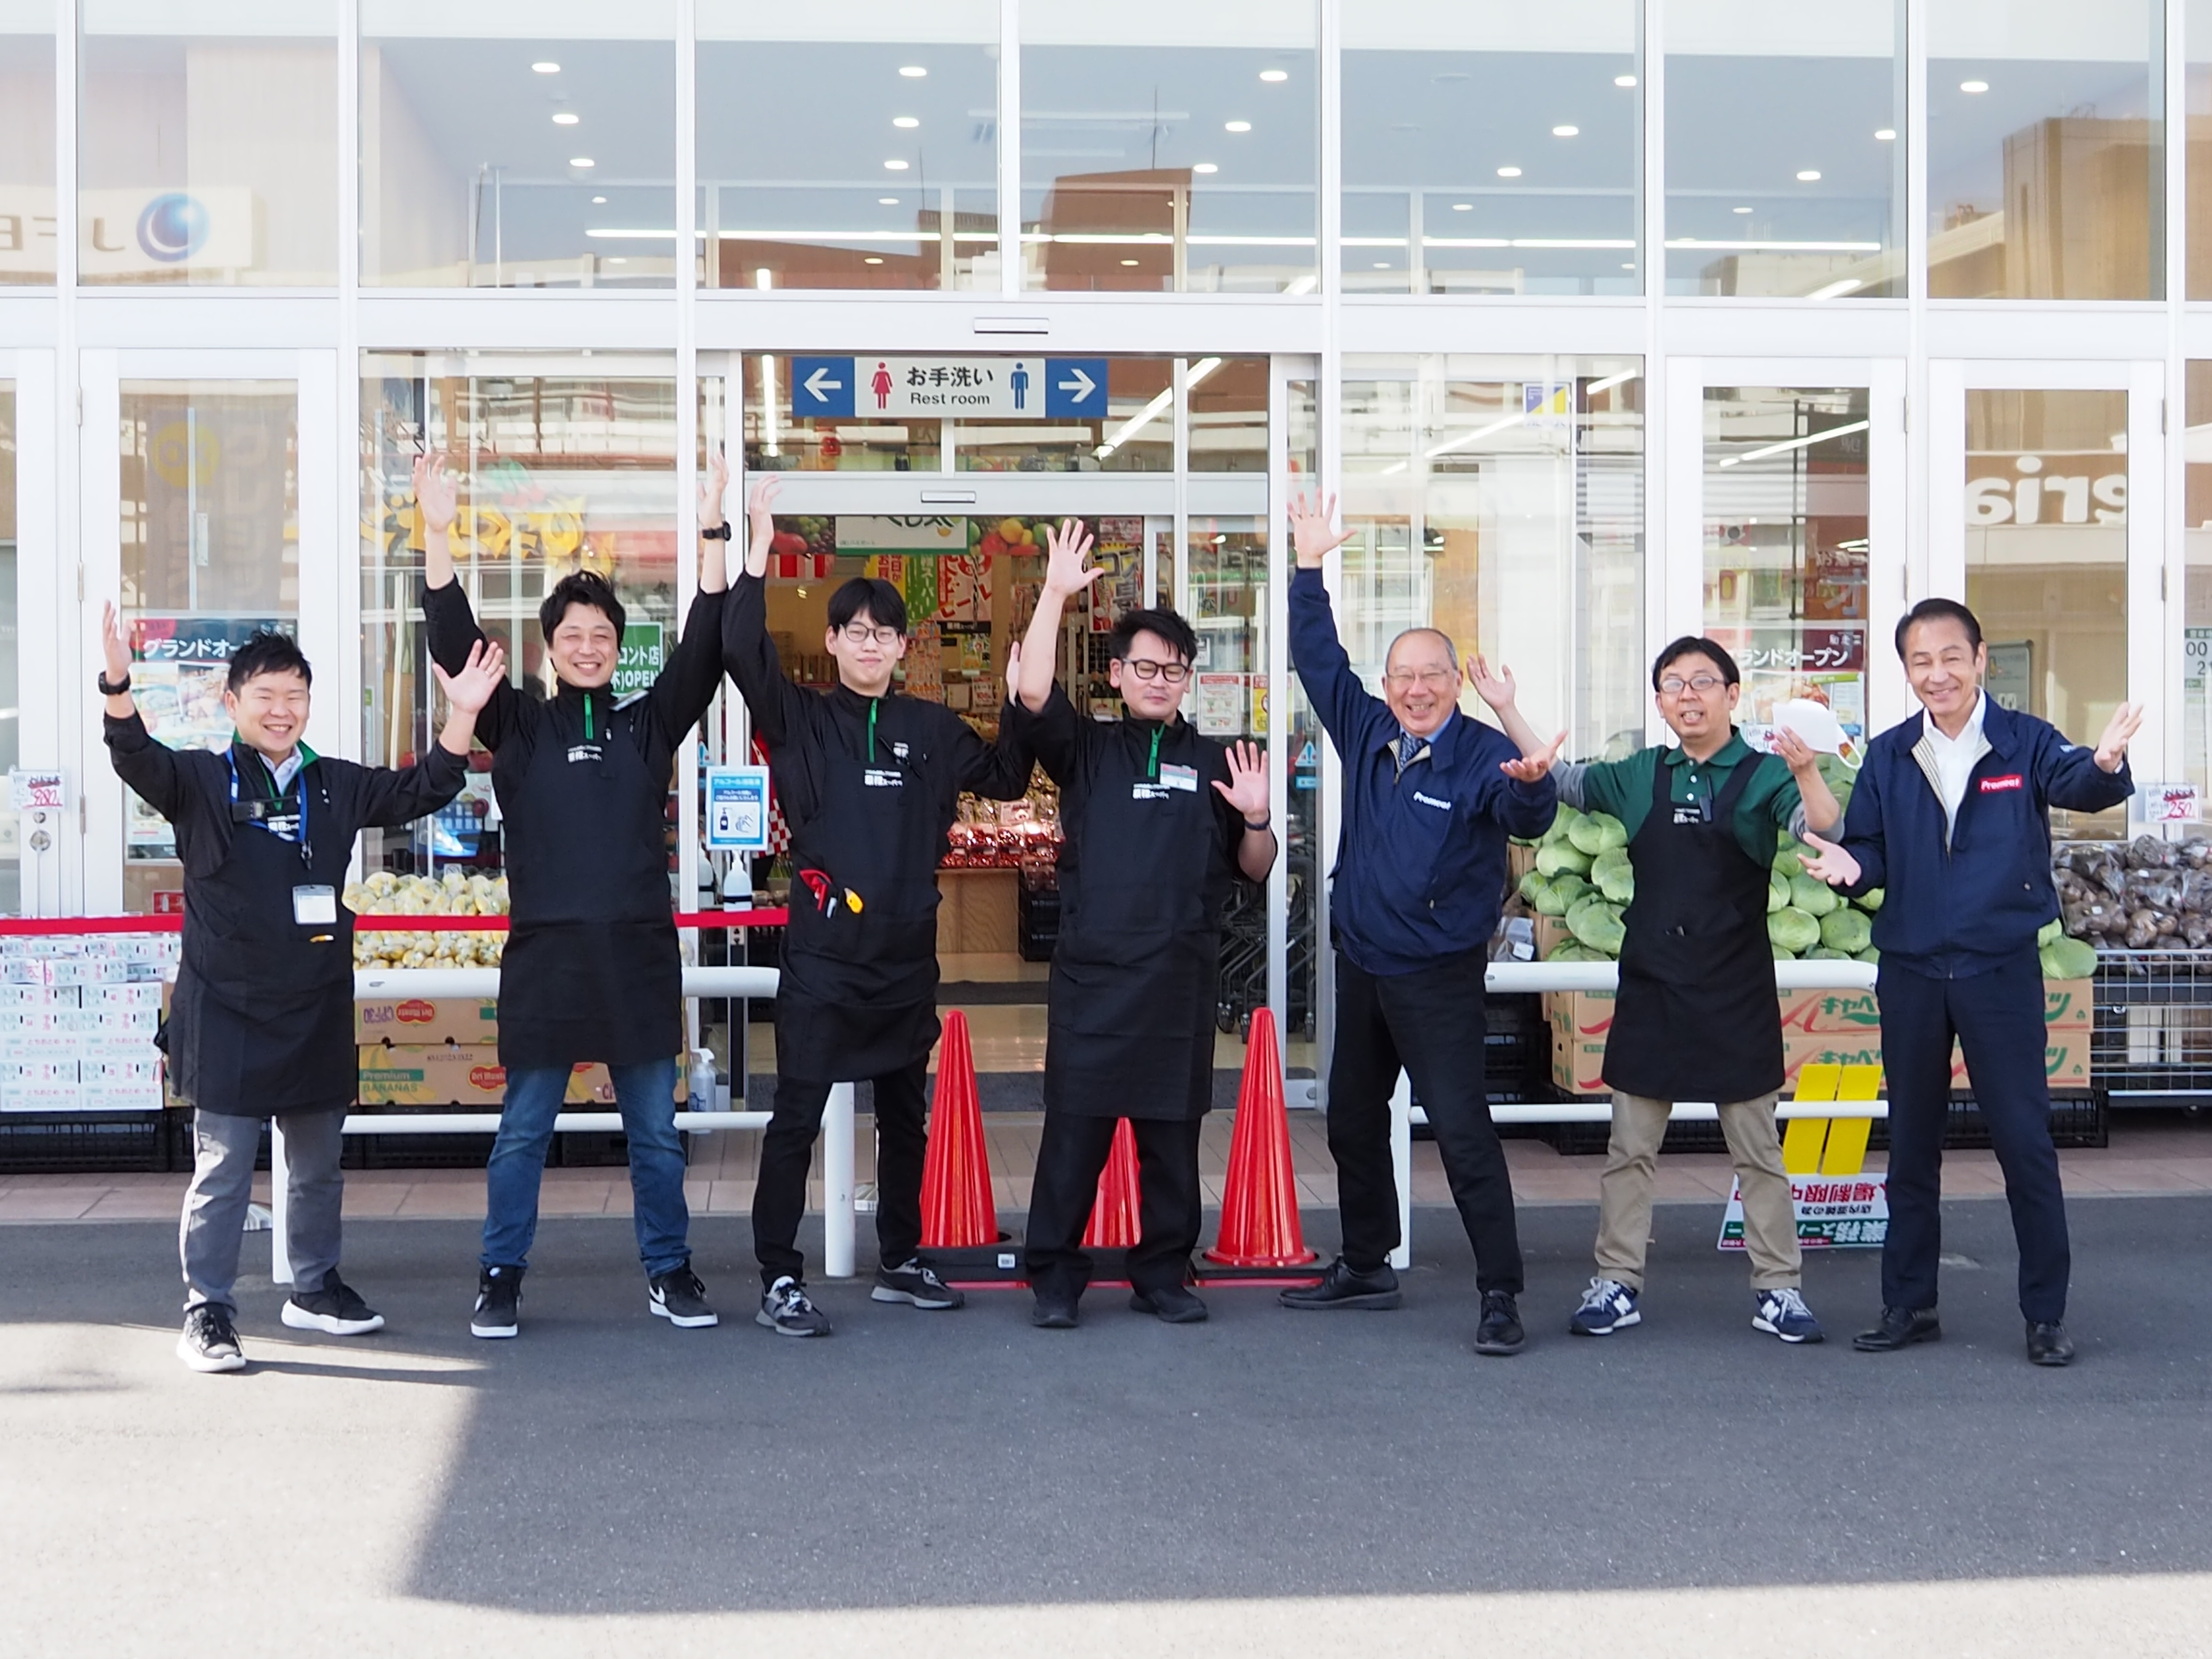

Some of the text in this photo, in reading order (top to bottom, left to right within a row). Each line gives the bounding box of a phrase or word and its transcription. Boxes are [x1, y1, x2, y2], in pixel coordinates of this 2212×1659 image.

[907, 366, 994, 387] お手洗い
[911, 392, 990, 405] Rest room
[363, 1070, 409, 1080] Premium
[363, 1082, 418, 1093] BANANAS
